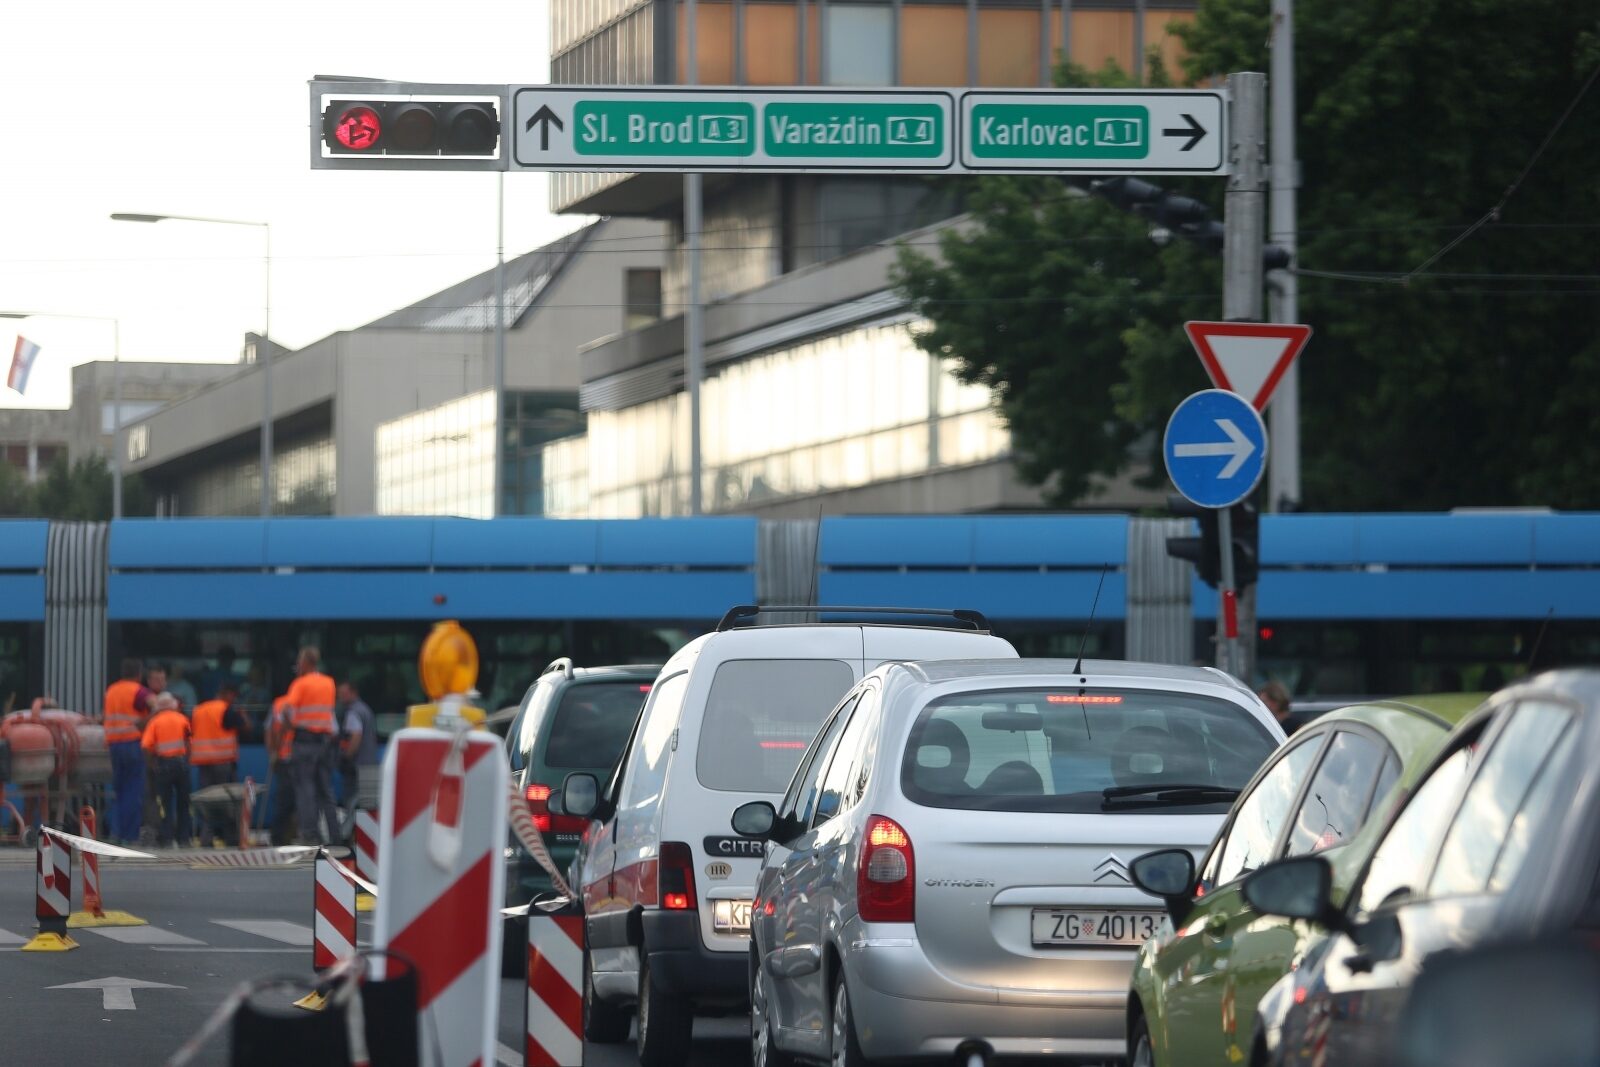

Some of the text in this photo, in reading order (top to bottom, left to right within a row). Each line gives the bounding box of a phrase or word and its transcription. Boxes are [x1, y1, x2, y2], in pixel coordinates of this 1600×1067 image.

[582, 113, 740, 143] Sl. Brod A 3
[769, 115, 927, 145] Varaždin A 4
[979, 117, 1131, 146] Karlovac A 1
[711, 864, 727, 876] HR
[1051, 914, 1079, 939] ZG
